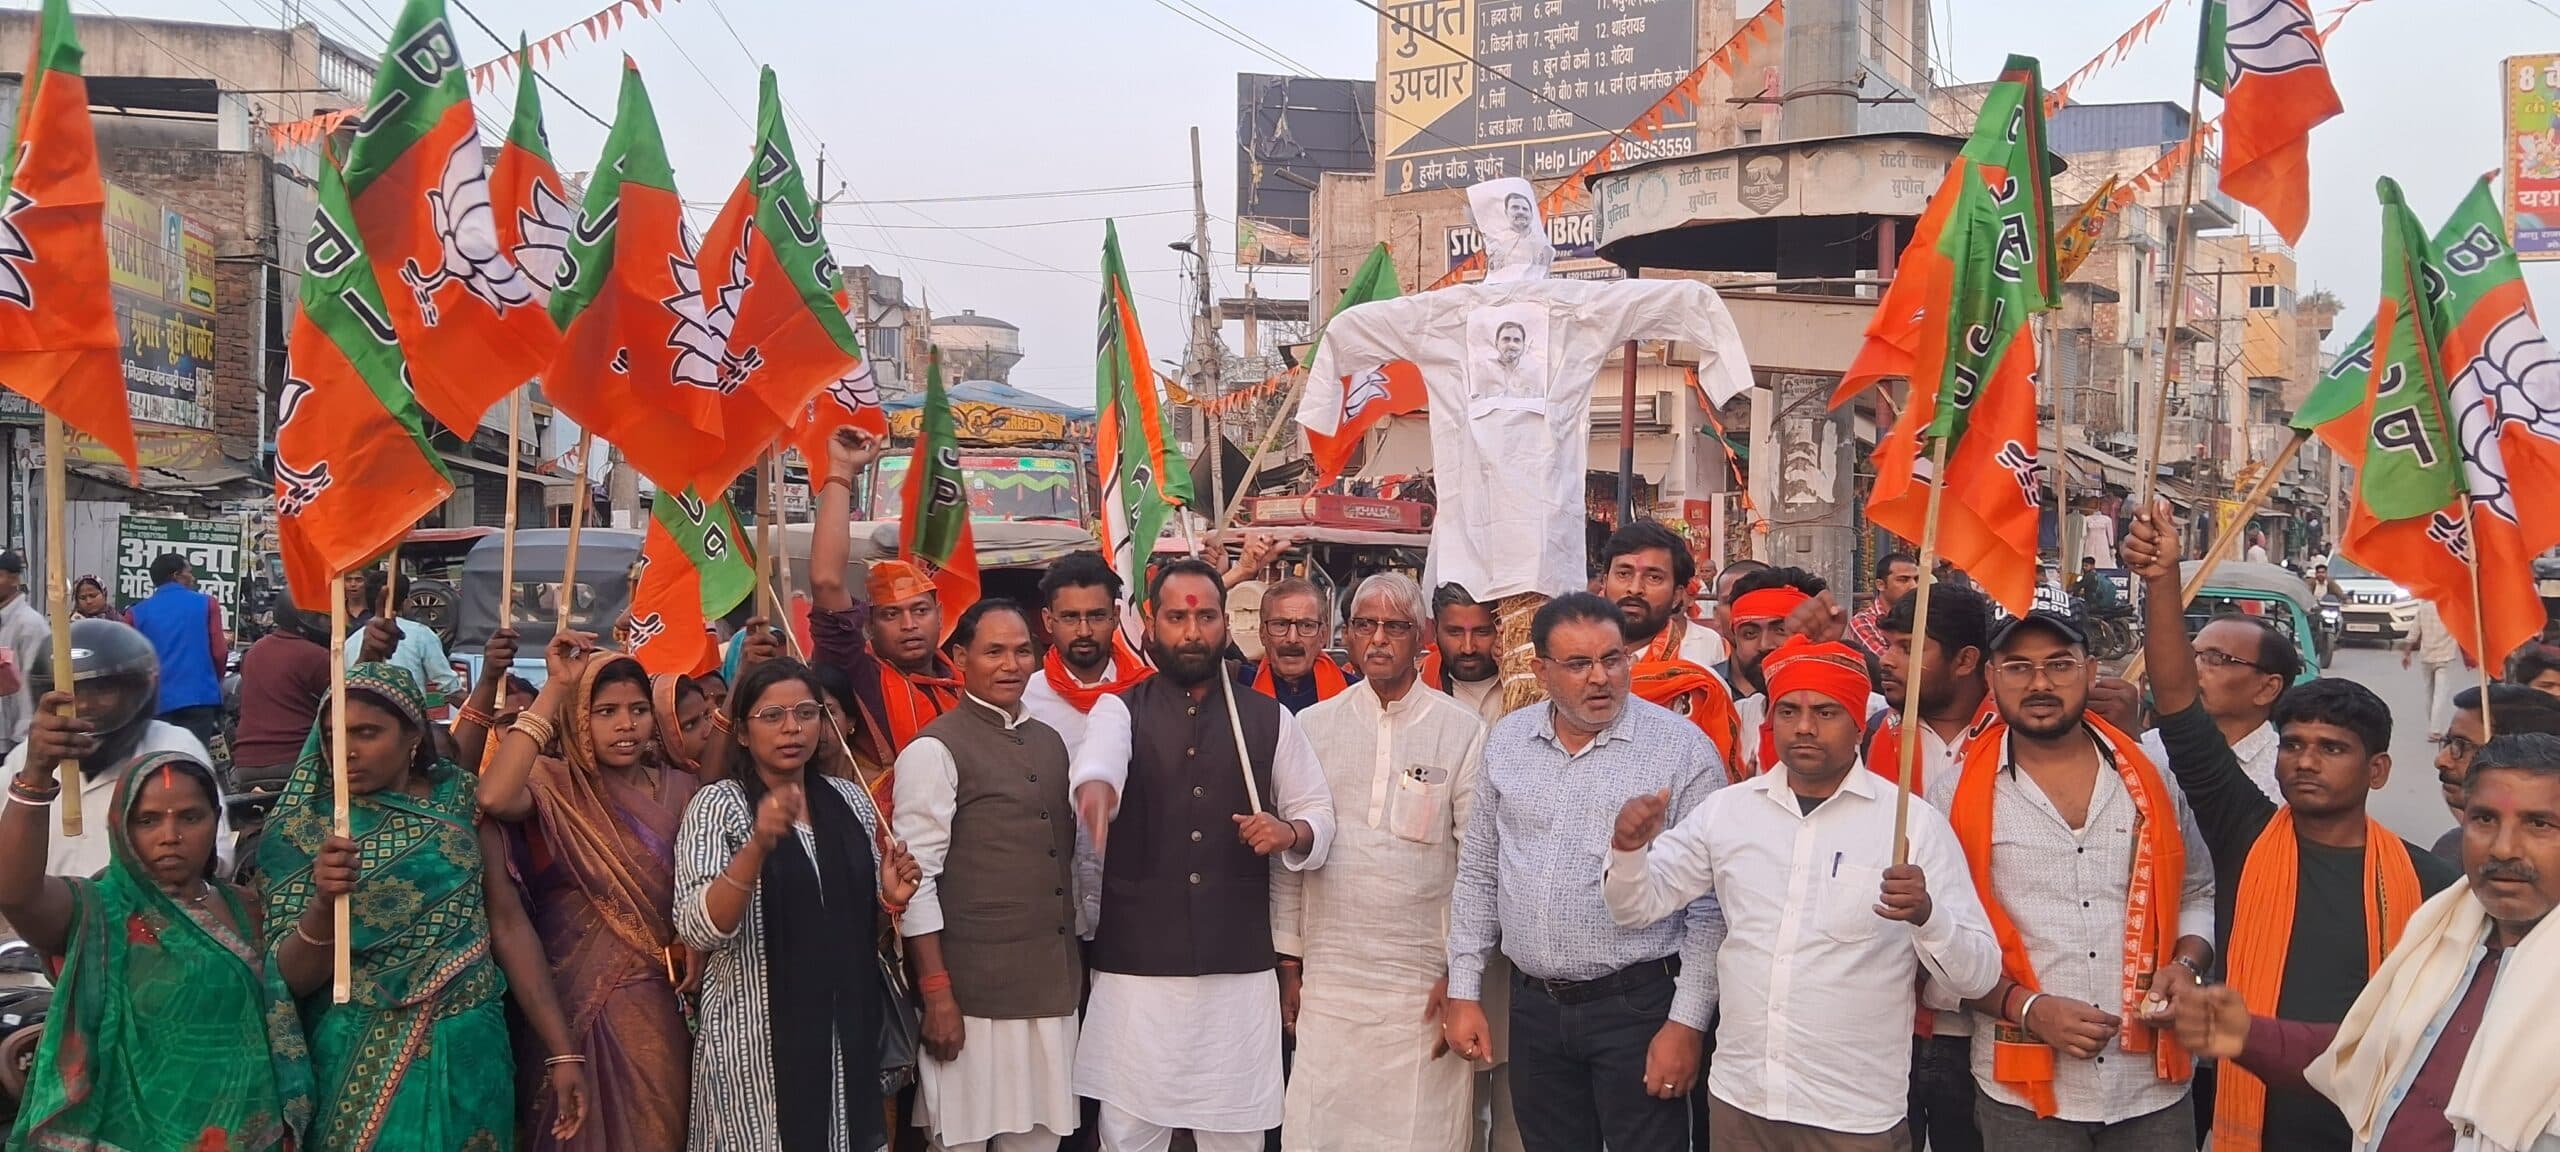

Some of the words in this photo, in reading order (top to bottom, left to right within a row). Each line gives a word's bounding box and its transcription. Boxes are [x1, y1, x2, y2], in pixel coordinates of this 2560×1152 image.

[1510, 2, 1523, 22] रोग
[1534, 3, 1543, 19] 6.
[1534, 31, 1543, 47] 7.
[1595, 23, 1609, 39] 12.
[1480, 39, 1489, 55] 2.
[1490, 30, 1513, 54] किडनी
[1515, 29, 1529, 49] रोग
[1532, 60, 1542, 76] 8.
[1544, 57, 1559, 79] खून
[1560, 50, 1571, 71] की
[1573, 48, 1590, 69] कमी
[1595, 52, 1608, 68] 13.
[1389, 61, 1468, 104] उपचार
[1575, 78, 1589, 98] रोग
[1594, 80, 1608, 97] 14.
[1610, 72, 1624, 94] चर्म
[1625, 72, 1637, 95] एवं
[1639, 68, 1673, 91] मानसिक
[1479, 95, 1488, 110] 4.
[1479, 122, 1487, 137] 5.
[1532, 116, 1546, 132] 10.
[1548, 109, 1573, 131] पीलिया
[1535, 150, 1565, 174] Help
[1568, 147, 1597, 167] Line
[1678, 166, 1702, 186] रोटरी
[1705, 165, 1730, 182] क्लब
[1450, 228, 1483, 257] STU
[1548, 214, 1594, 246] IBRA
